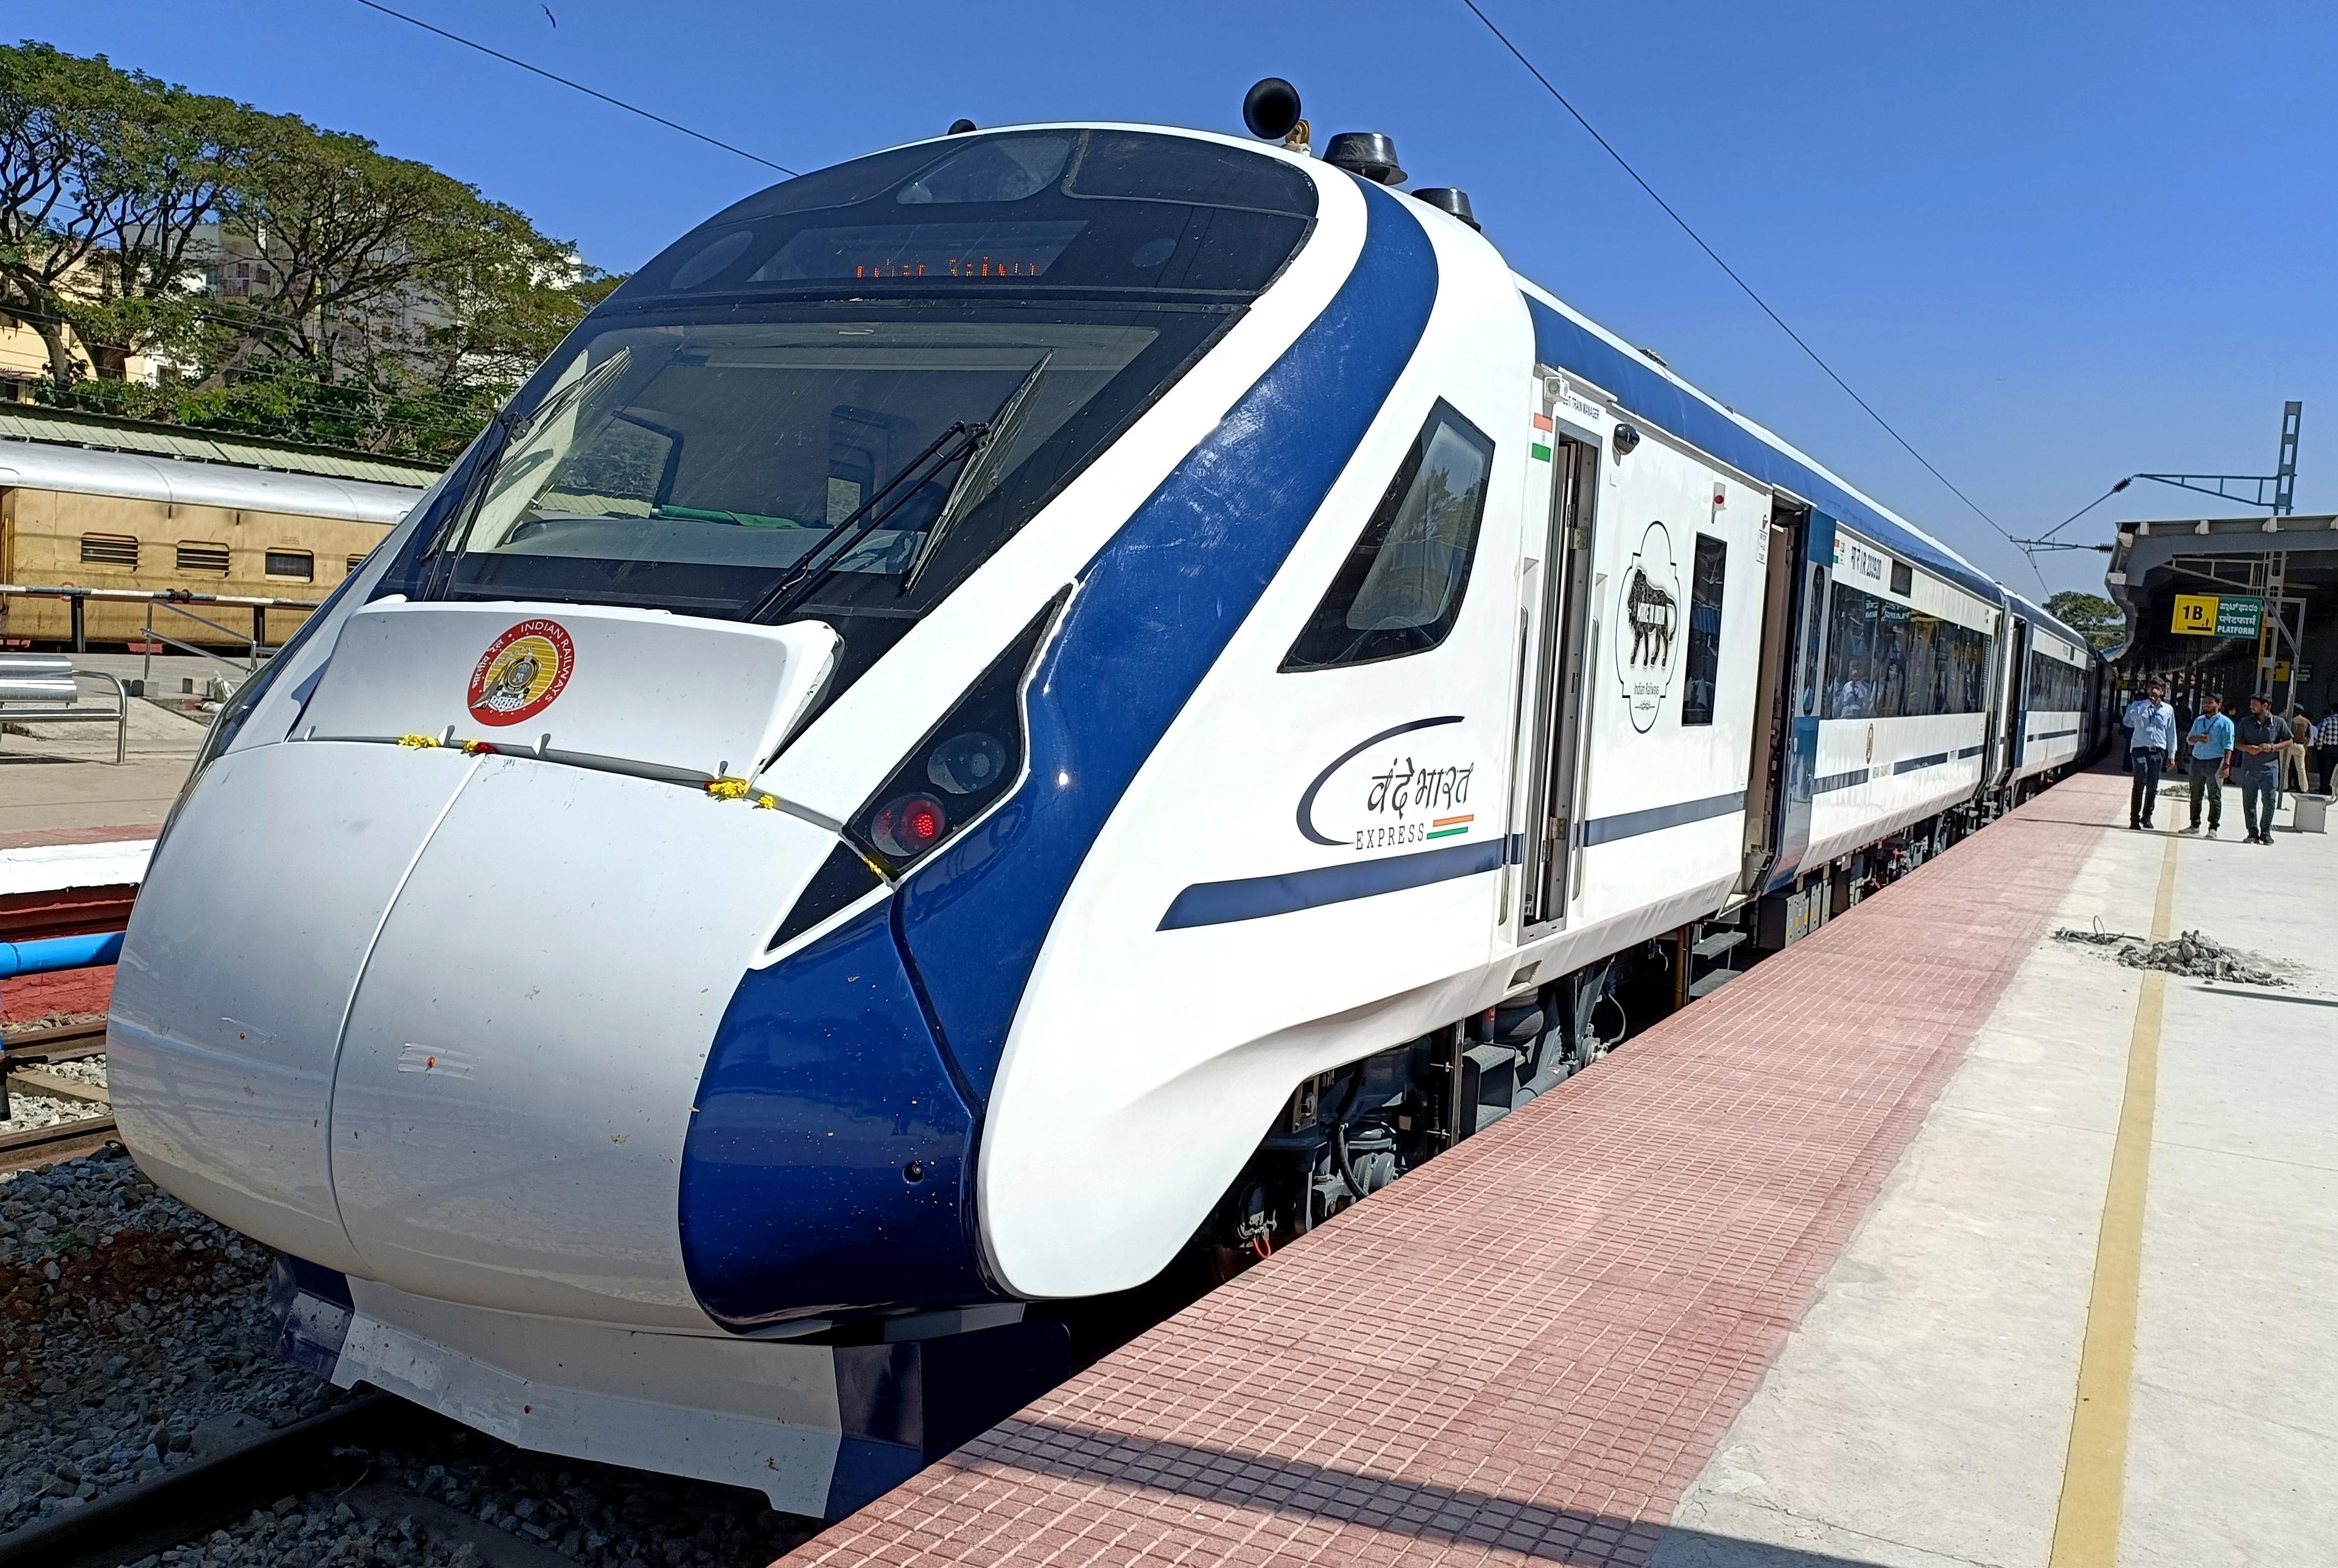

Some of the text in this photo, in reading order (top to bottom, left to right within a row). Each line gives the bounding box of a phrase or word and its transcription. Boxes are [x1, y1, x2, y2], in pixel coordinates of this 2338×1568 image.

[2182, 604, 2203, 621] 1B
[2217, 625, 2255, 635] PLATFORM
[471, 655, 491, 690] भारतीय
[521, 621, 572, 702] INDIAN RAILWAYS
[1634, 682, 1660, 698] Indian Railways
[1355, 822, 1425, 850] EXPRESS
